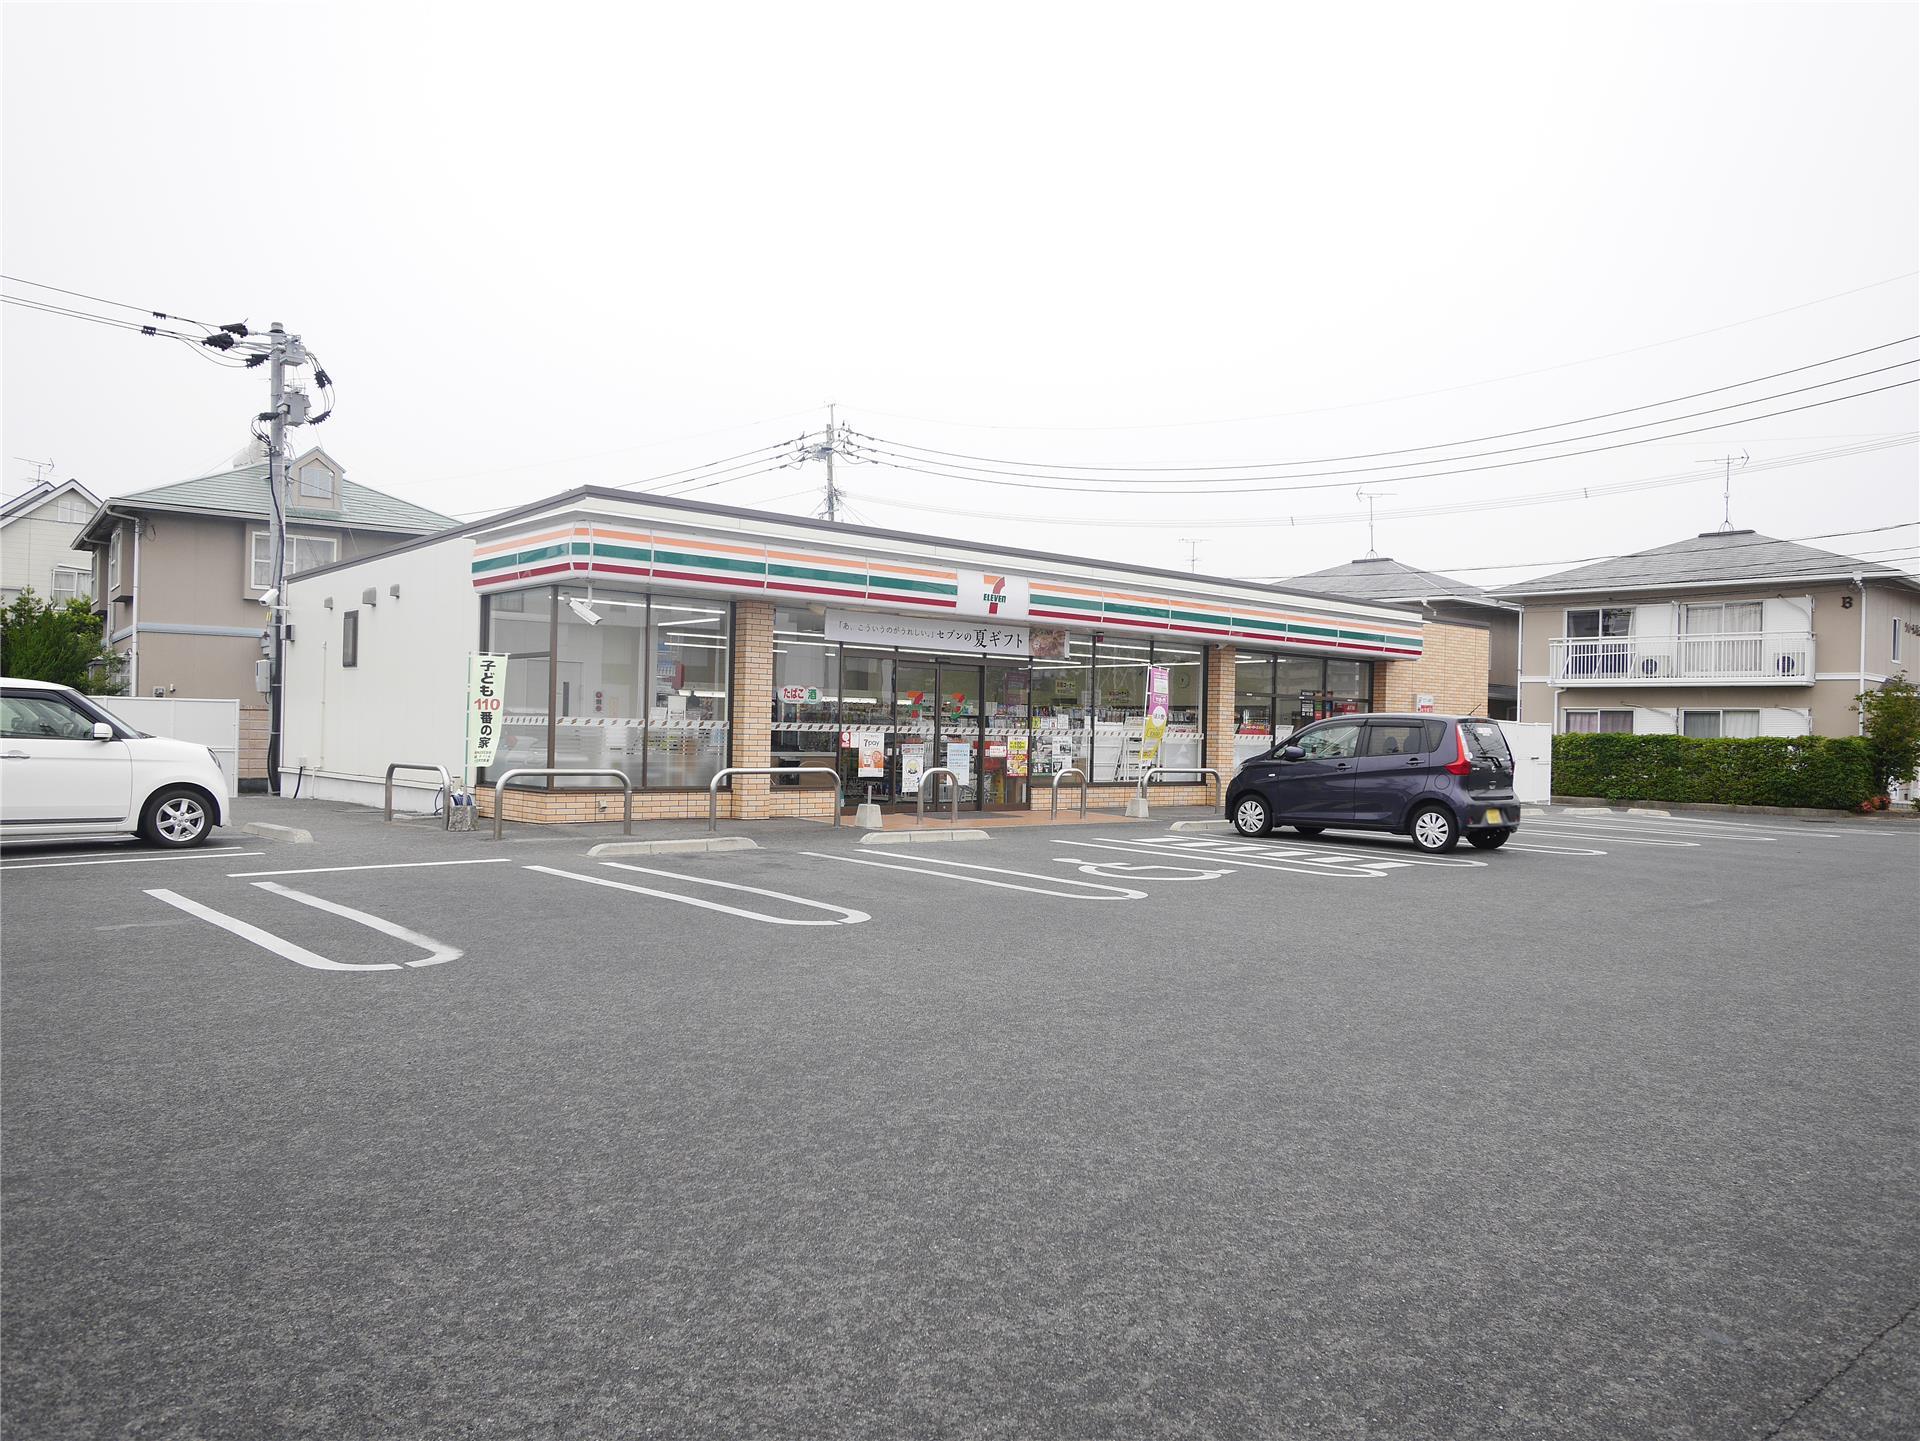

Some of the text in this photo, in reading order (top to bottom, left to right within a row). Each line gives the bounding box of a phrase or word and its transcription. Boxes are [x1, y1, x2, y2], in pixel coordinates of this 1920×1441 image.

[474, 660, 501, 749] 子ども110番の家
[783, 688, 817, 700] たばこ 酒
